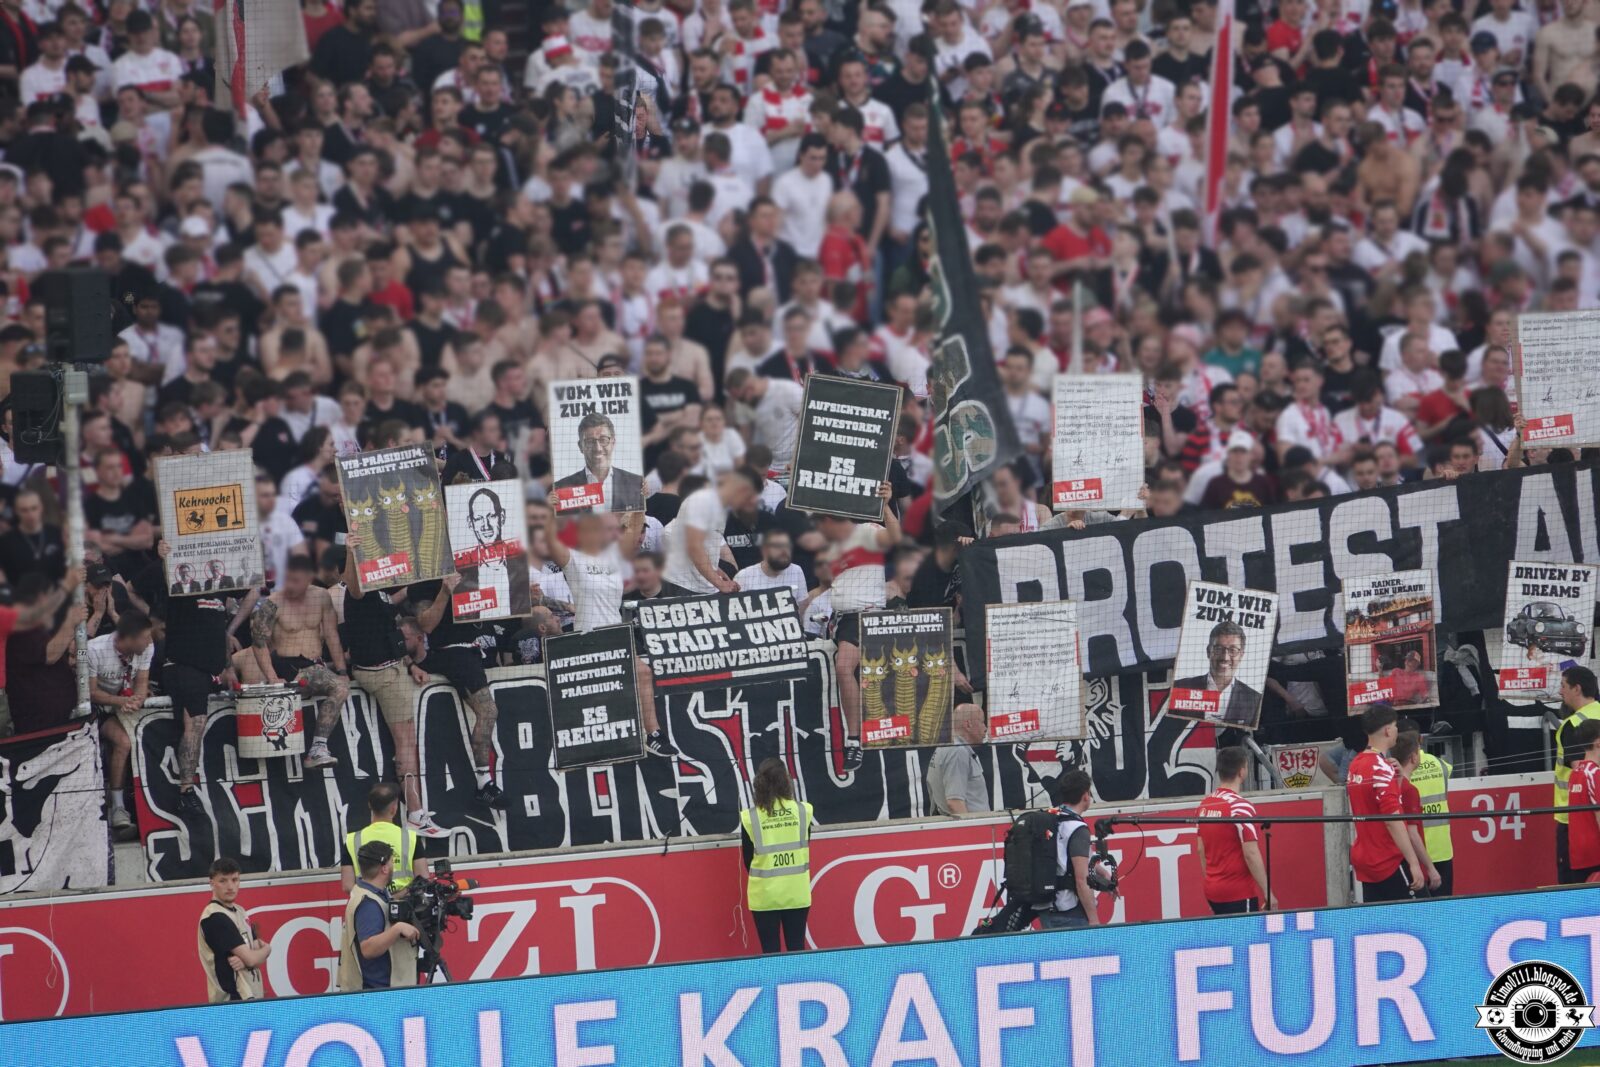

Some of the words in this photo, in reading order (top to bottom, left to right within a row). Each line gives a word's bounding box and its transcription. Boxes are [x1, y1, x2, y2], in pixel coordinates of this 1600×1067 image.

[554, 385, 592, 401] VOM
[596, 382, 632, 399] WIR
[560, 402, 598, 418] ZUM
[601, 399, 629, 416] ICH
[808, 400, 892, 421] AUFSICHTSRAT,
[812, 416, 884, 435] INVESTOREN,
[1541, 416, 1556, 427] ES
[813, 431, 878, 449] PRÄSIDIUM:
[1528, 425, 1572, 440] REICHT!
[347, 463, 397, 479] RÜCKTRITT
[398, 457, 428, 471] JETZT!
[829, 456, 856, 476] ES
[572, 486, 586, 497] ES
[797, 469, 882, 497] REICHT!
[1071, 480, 1085, 490] ES
[178, 493, 232, 509] Kehrwoche
[560, 494, 601, 509] REICHT!
[1058, 489, 1100, 501] REICHT!
[377, 556, 391, 569] ES
[365, 563, 408, 583] REICHT!
[996, 484, 1461, 676] PROTEST
[1514, 566, 1567, 582] DRIVEN
[1572, 569, 1592, 583] BY
[469, 591, 481, 602] ES
[1351, 590, 1362, 599] AB
[1363, 588, 1372, 598] IN
[1373, 587, 1391, 596] DEN
[1392, 583, 1426, 595] URLAUB!
[1521, 583, 1581, 599] DREAMS
[458, 599, 494, 615] REICHT!
[1195, 587, 1233, 607] VOM
[1237, 594, 1272, 614] WIR
[639, 599, 722, 630] GEGEN
[728, 590, 796, 622] ALLE
[1195, 605, 1234, 623] ZUM
[1237, 613, 1266, 630] ICH
[645, 626, 741, 656] STADT-
[744, 616, 803, 645] UND
[867, 624, 913, 636] RÜCKTRITT
[914, 623, 944, 634] JETZT!
[550, 649, 630, 669] AUFSICHTSRAT,
[652, 641, 808, 676] STADIONVERBOTE!
[557, 665, 626, 684] INVESTOREN,
[1516, 668, 1530, 679] ES
[561, 679, 624, 699] PRÄSIDIUM:
[1365, 681, 1379, 692] ES
[1503, 676, 1544, 690] REICHT!
[1190, 690, 1203, 700] ES
[1353, 688, 1394, 705] REICHT!
[1174, 699, 1217, 711] REICHT!
[582, 705, 608, 726] ES
[879, 718, 893, 728] ES
[1007, 712, 1021, 723] ES
[557, 719, 637, 749] REICHT!
[866, 726, 907, 742] REICHT!
[995, 720, 1036, 737] REICHT!
[1471, 792, 1526, 844] 34
[773, 852, 795, 867] 2001
[680, 954, 1122, 1067] KRAFT
[1174, 911, 1436, 1063] FÜR
